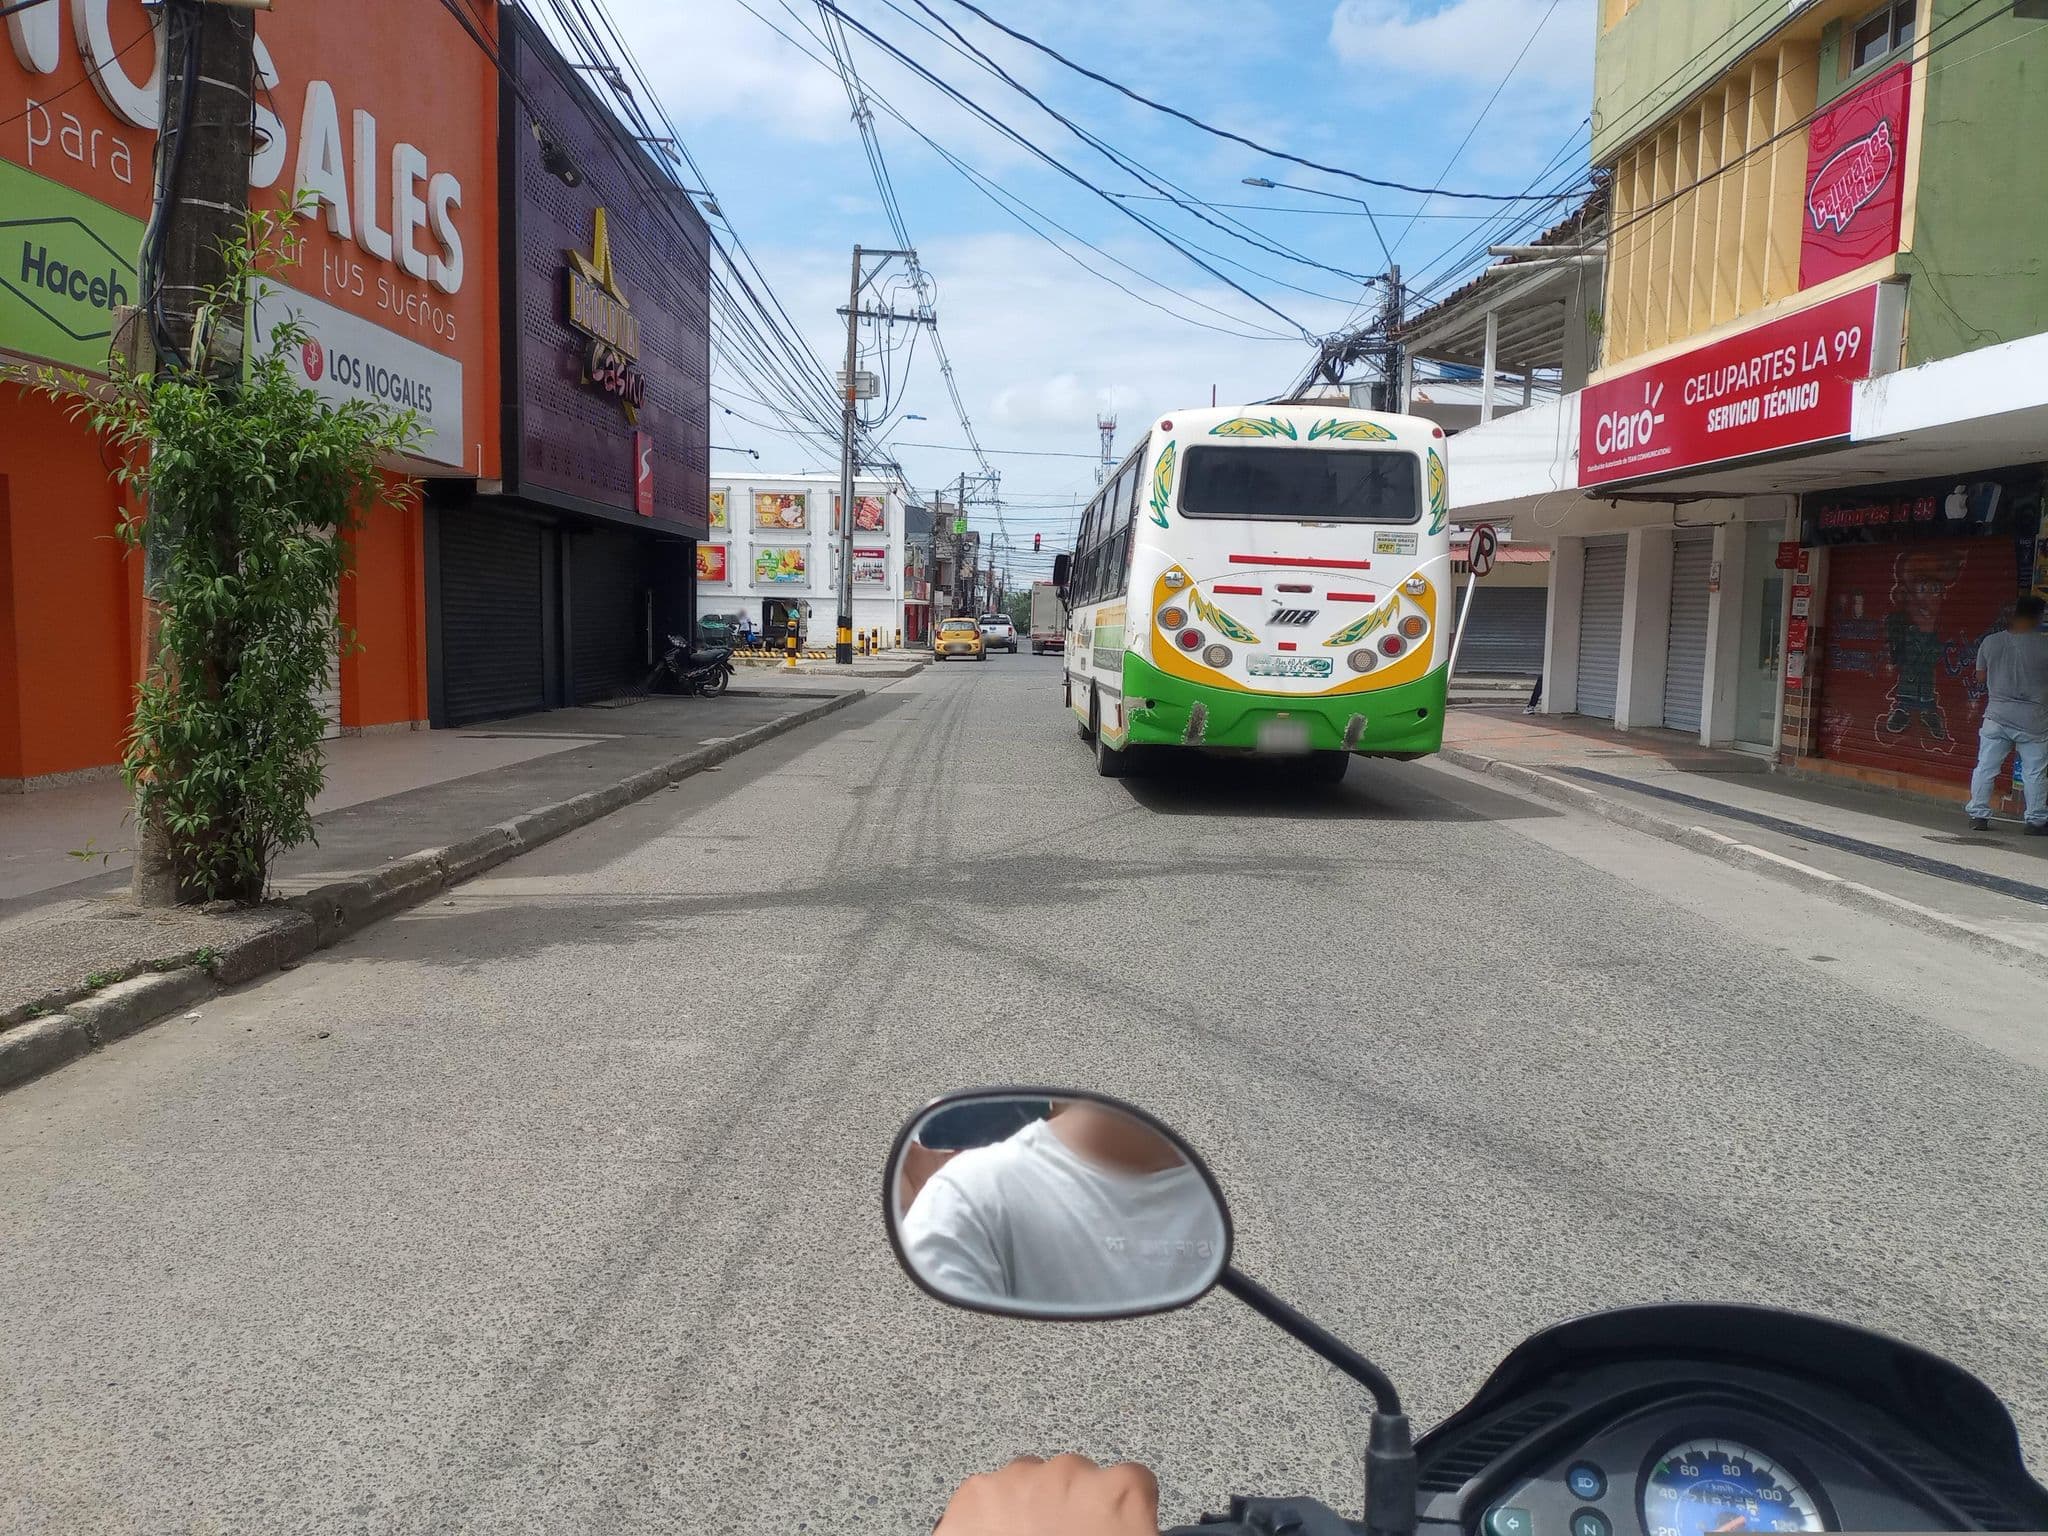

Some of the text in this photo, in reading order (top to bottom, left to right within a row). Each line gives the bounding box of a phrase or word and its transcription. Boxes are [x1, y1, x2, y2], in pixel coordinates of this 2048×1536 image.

[27, 98, 132, 185] para
[21, 240, 129, 312] Haceb
[322, 247, 366, 297] tus
[329, 349, 433, 413] LOS NOGALES
[1683, 325, 1862, 406] CELUPARTES LA 99
[1595, 405, 1655, 456] Claro
[1707, 380, 1820, 433] SERVICIO TÉCNICO
[1659, 1487, 1783, 1502] 40 100
[1680, 1463, 1742, 1478] 60 80
[1711, 1483, 1735, 1494] km/h
[1583, 1523, 1597, 1536] N
